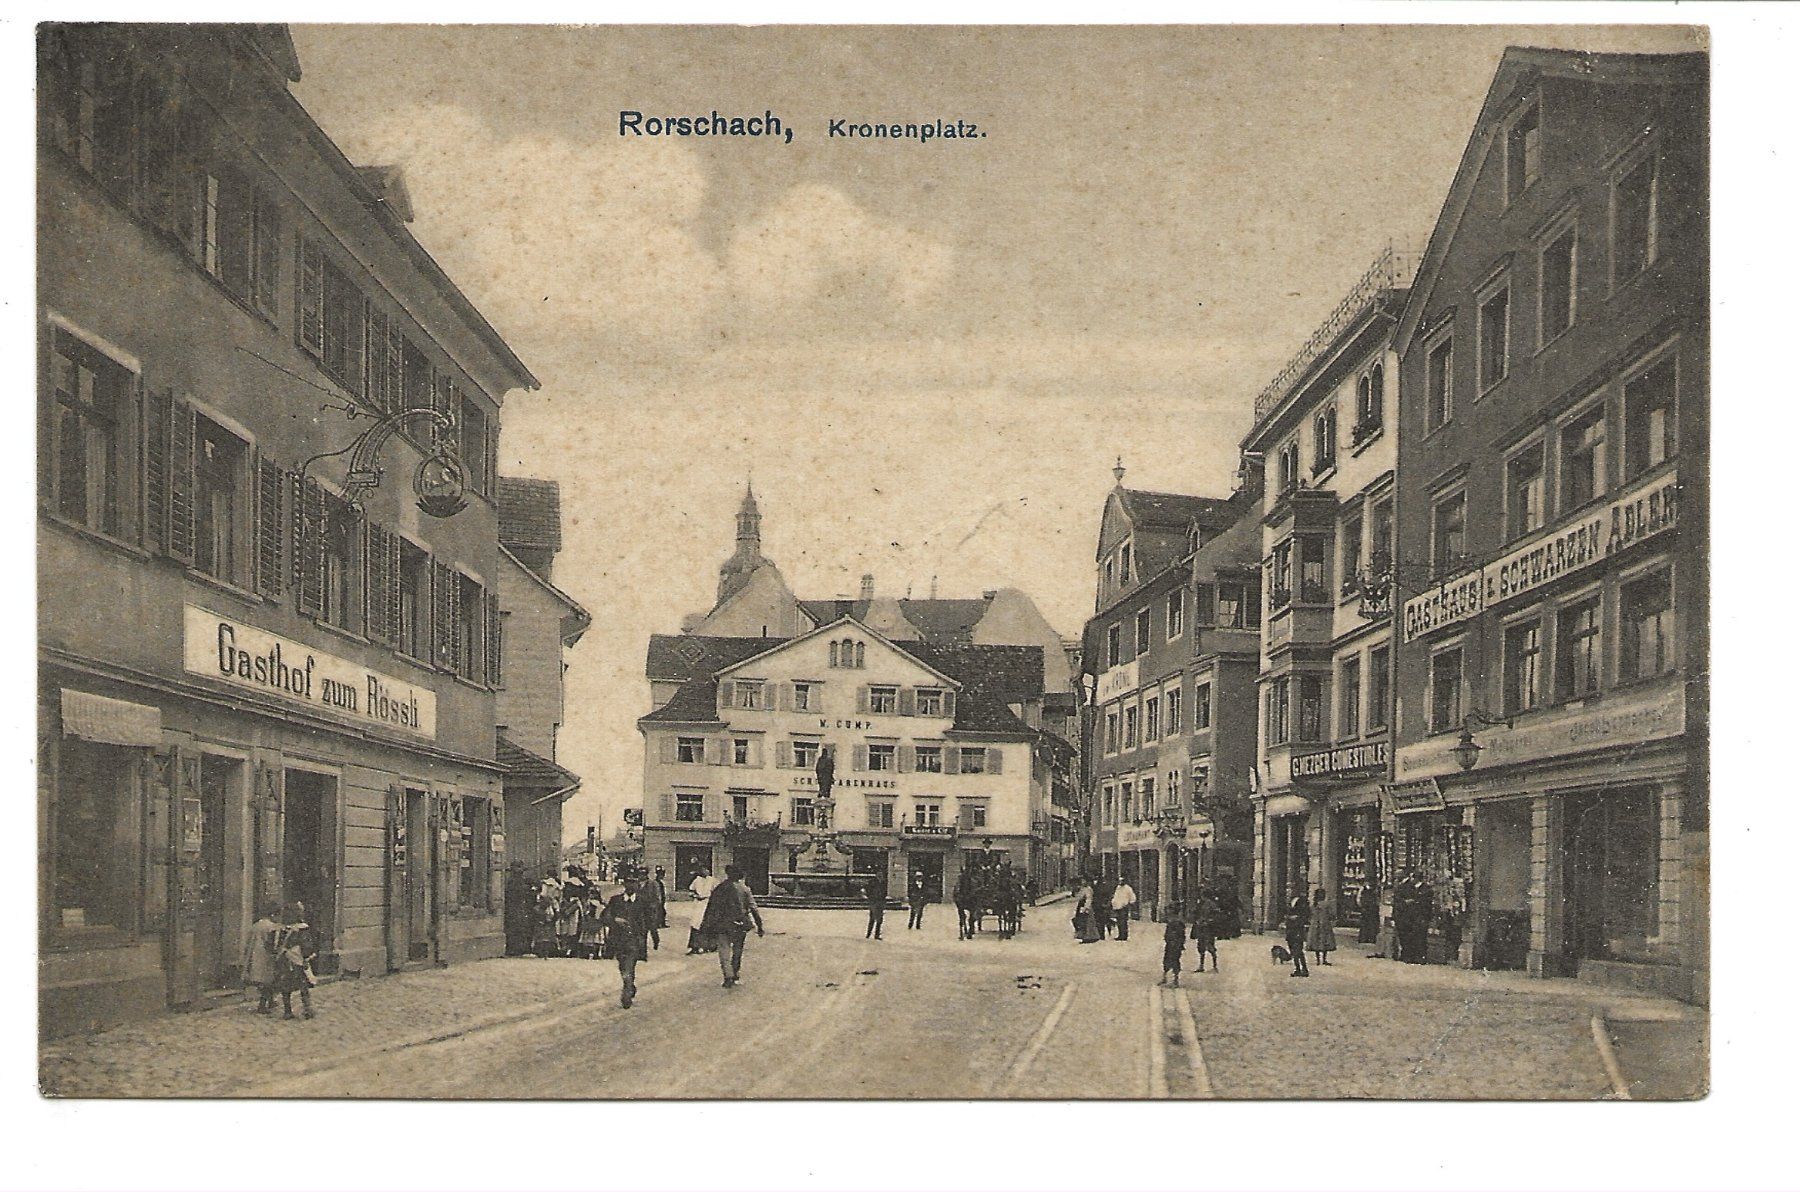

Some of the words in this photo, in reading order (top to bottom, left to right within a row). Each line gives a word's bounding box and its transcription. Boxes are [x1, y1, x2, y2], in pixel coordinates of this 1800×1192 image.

[1500, 518, 1601, 598] SCHWARZEN
[217, 622, 315, 699] Gasthof
[321, 677, 358, 712] zum
